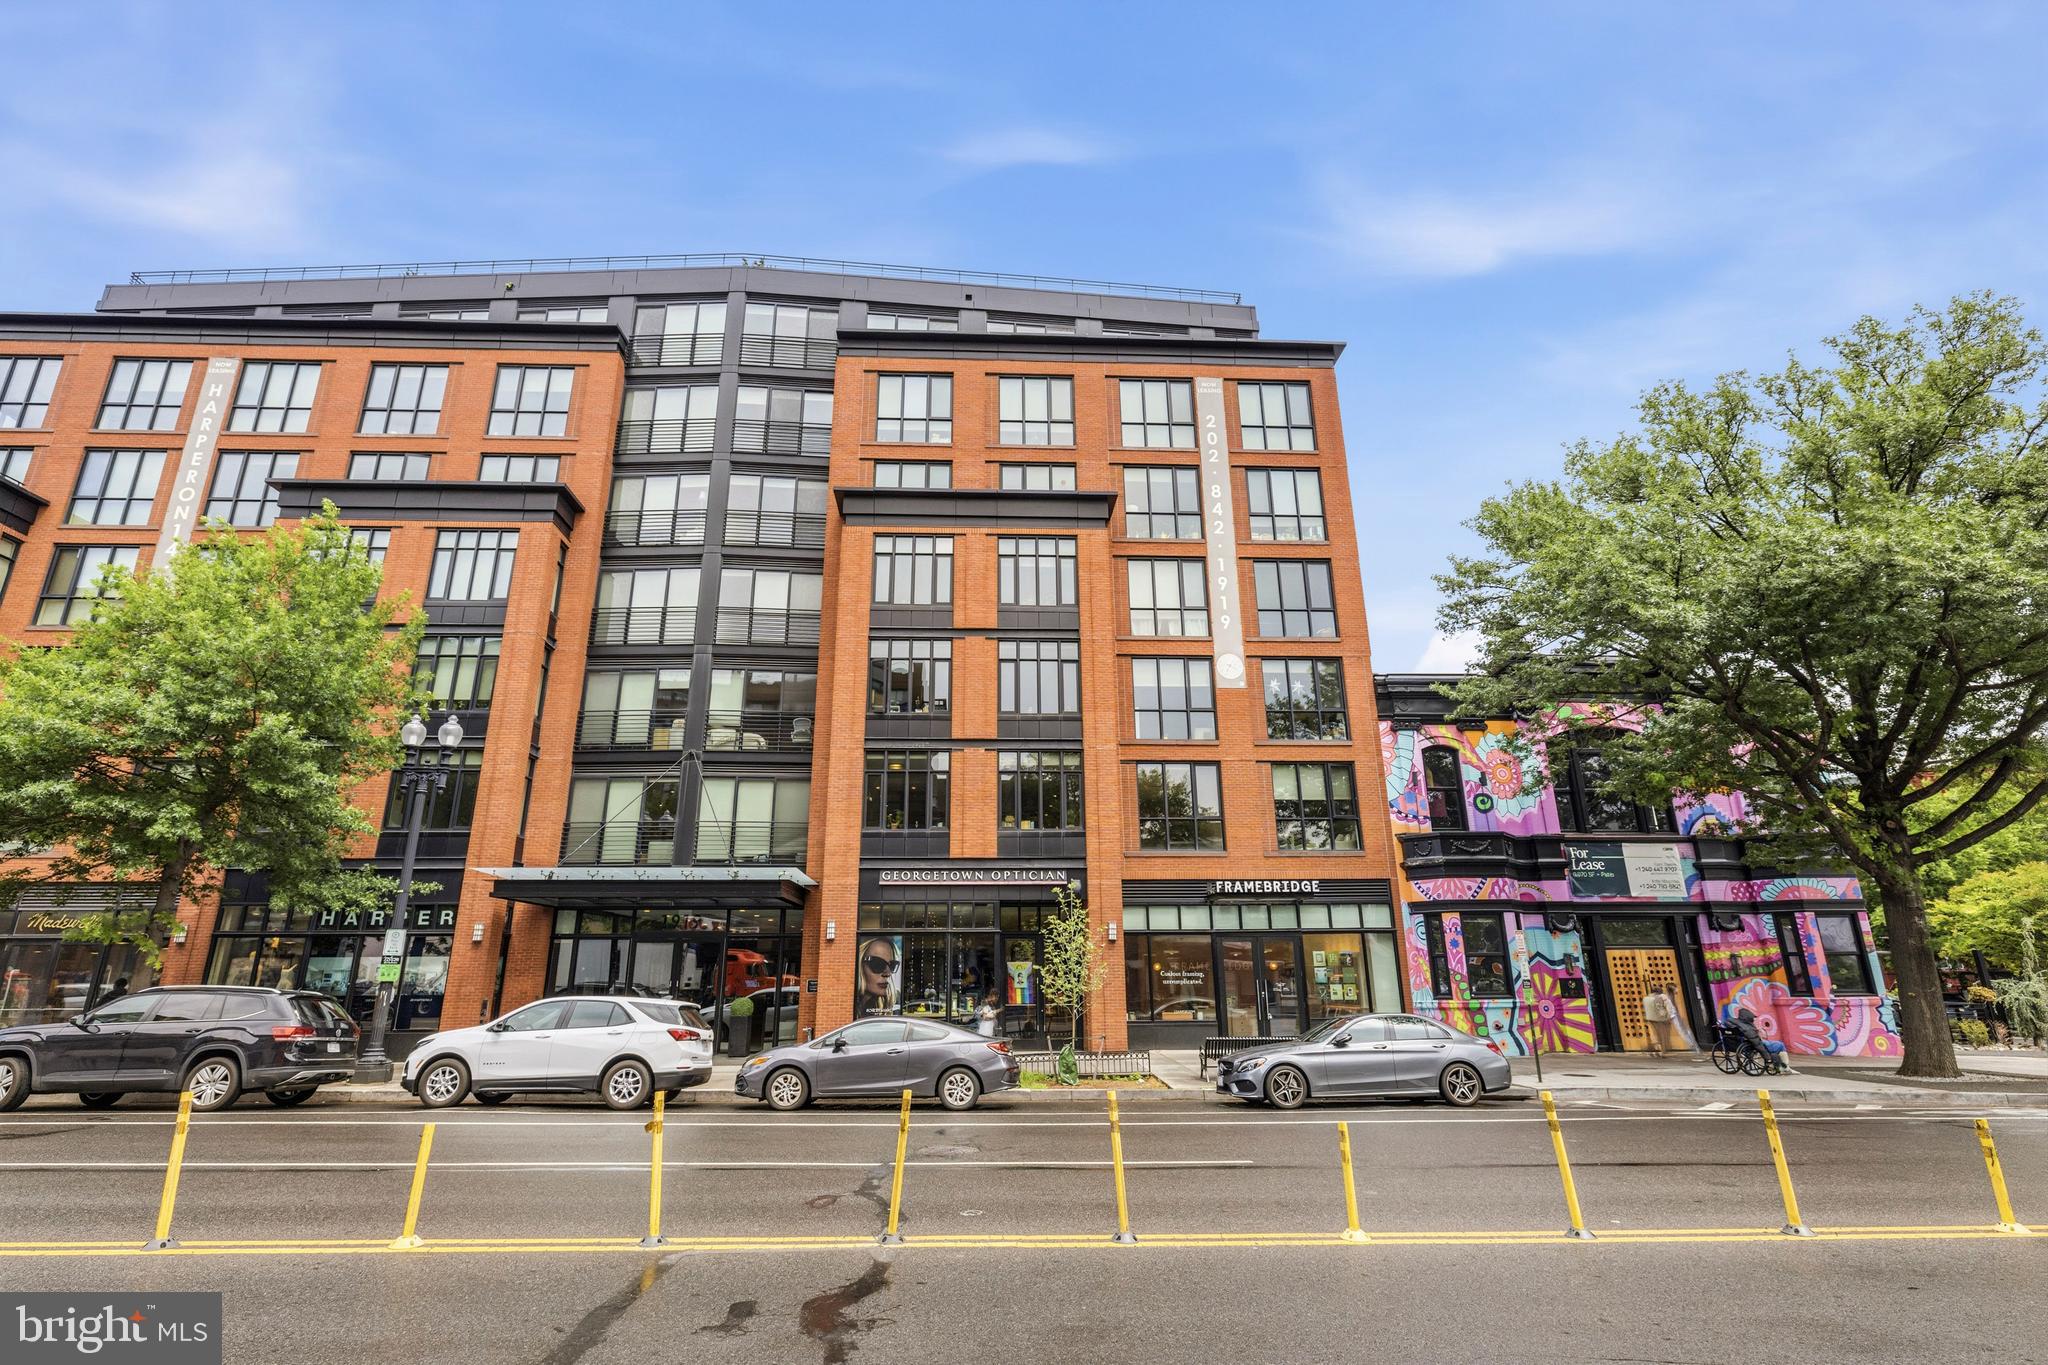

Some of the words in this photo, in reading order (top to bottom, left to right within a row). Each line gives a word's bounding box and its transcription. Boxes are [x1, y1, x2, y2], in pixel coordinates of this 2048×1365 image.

[215, 360, 233, 368] NOW
[1570, 847, 1589, 859] For
[1571, 858, 1606, 870] Lease
[881, 870, 984, 881] GEORGETOWN
[991, 870, 1066, 880] OPTICIAN
[1215, 880, 1320, 893] FRAMEBRIDGE
[320, 910, 454, 926] HARER
